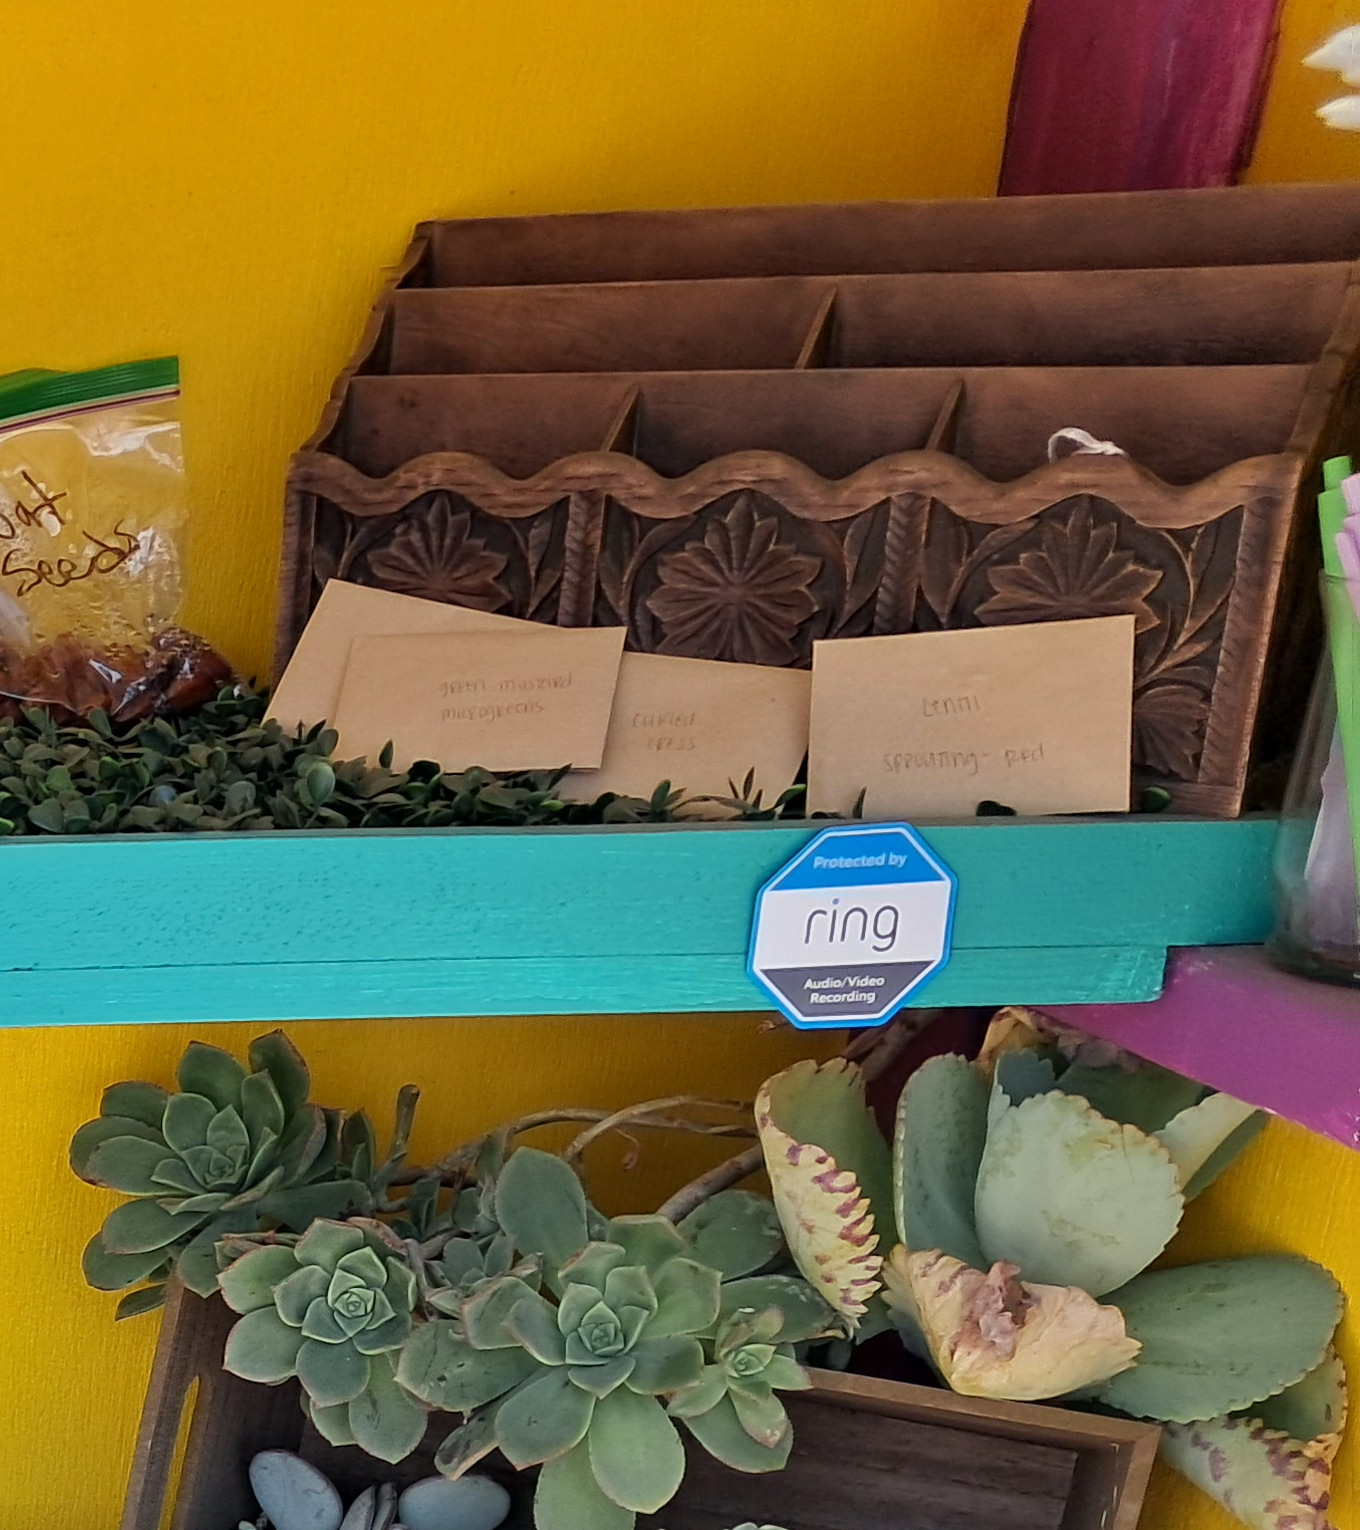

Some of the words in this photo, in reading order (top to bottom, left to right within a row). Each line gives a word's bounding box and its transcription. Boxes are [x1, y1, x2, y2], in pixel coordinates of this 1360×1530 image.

[2, 518, 141, 596] Seeds
[813, 852, 886, 868] Protected
[888, 852, 907, 867] by
[804, 898, 899, 952] ring
[803, 976, 885, 990] Audio/Video
[810, 991, 875, 1004] Recording
